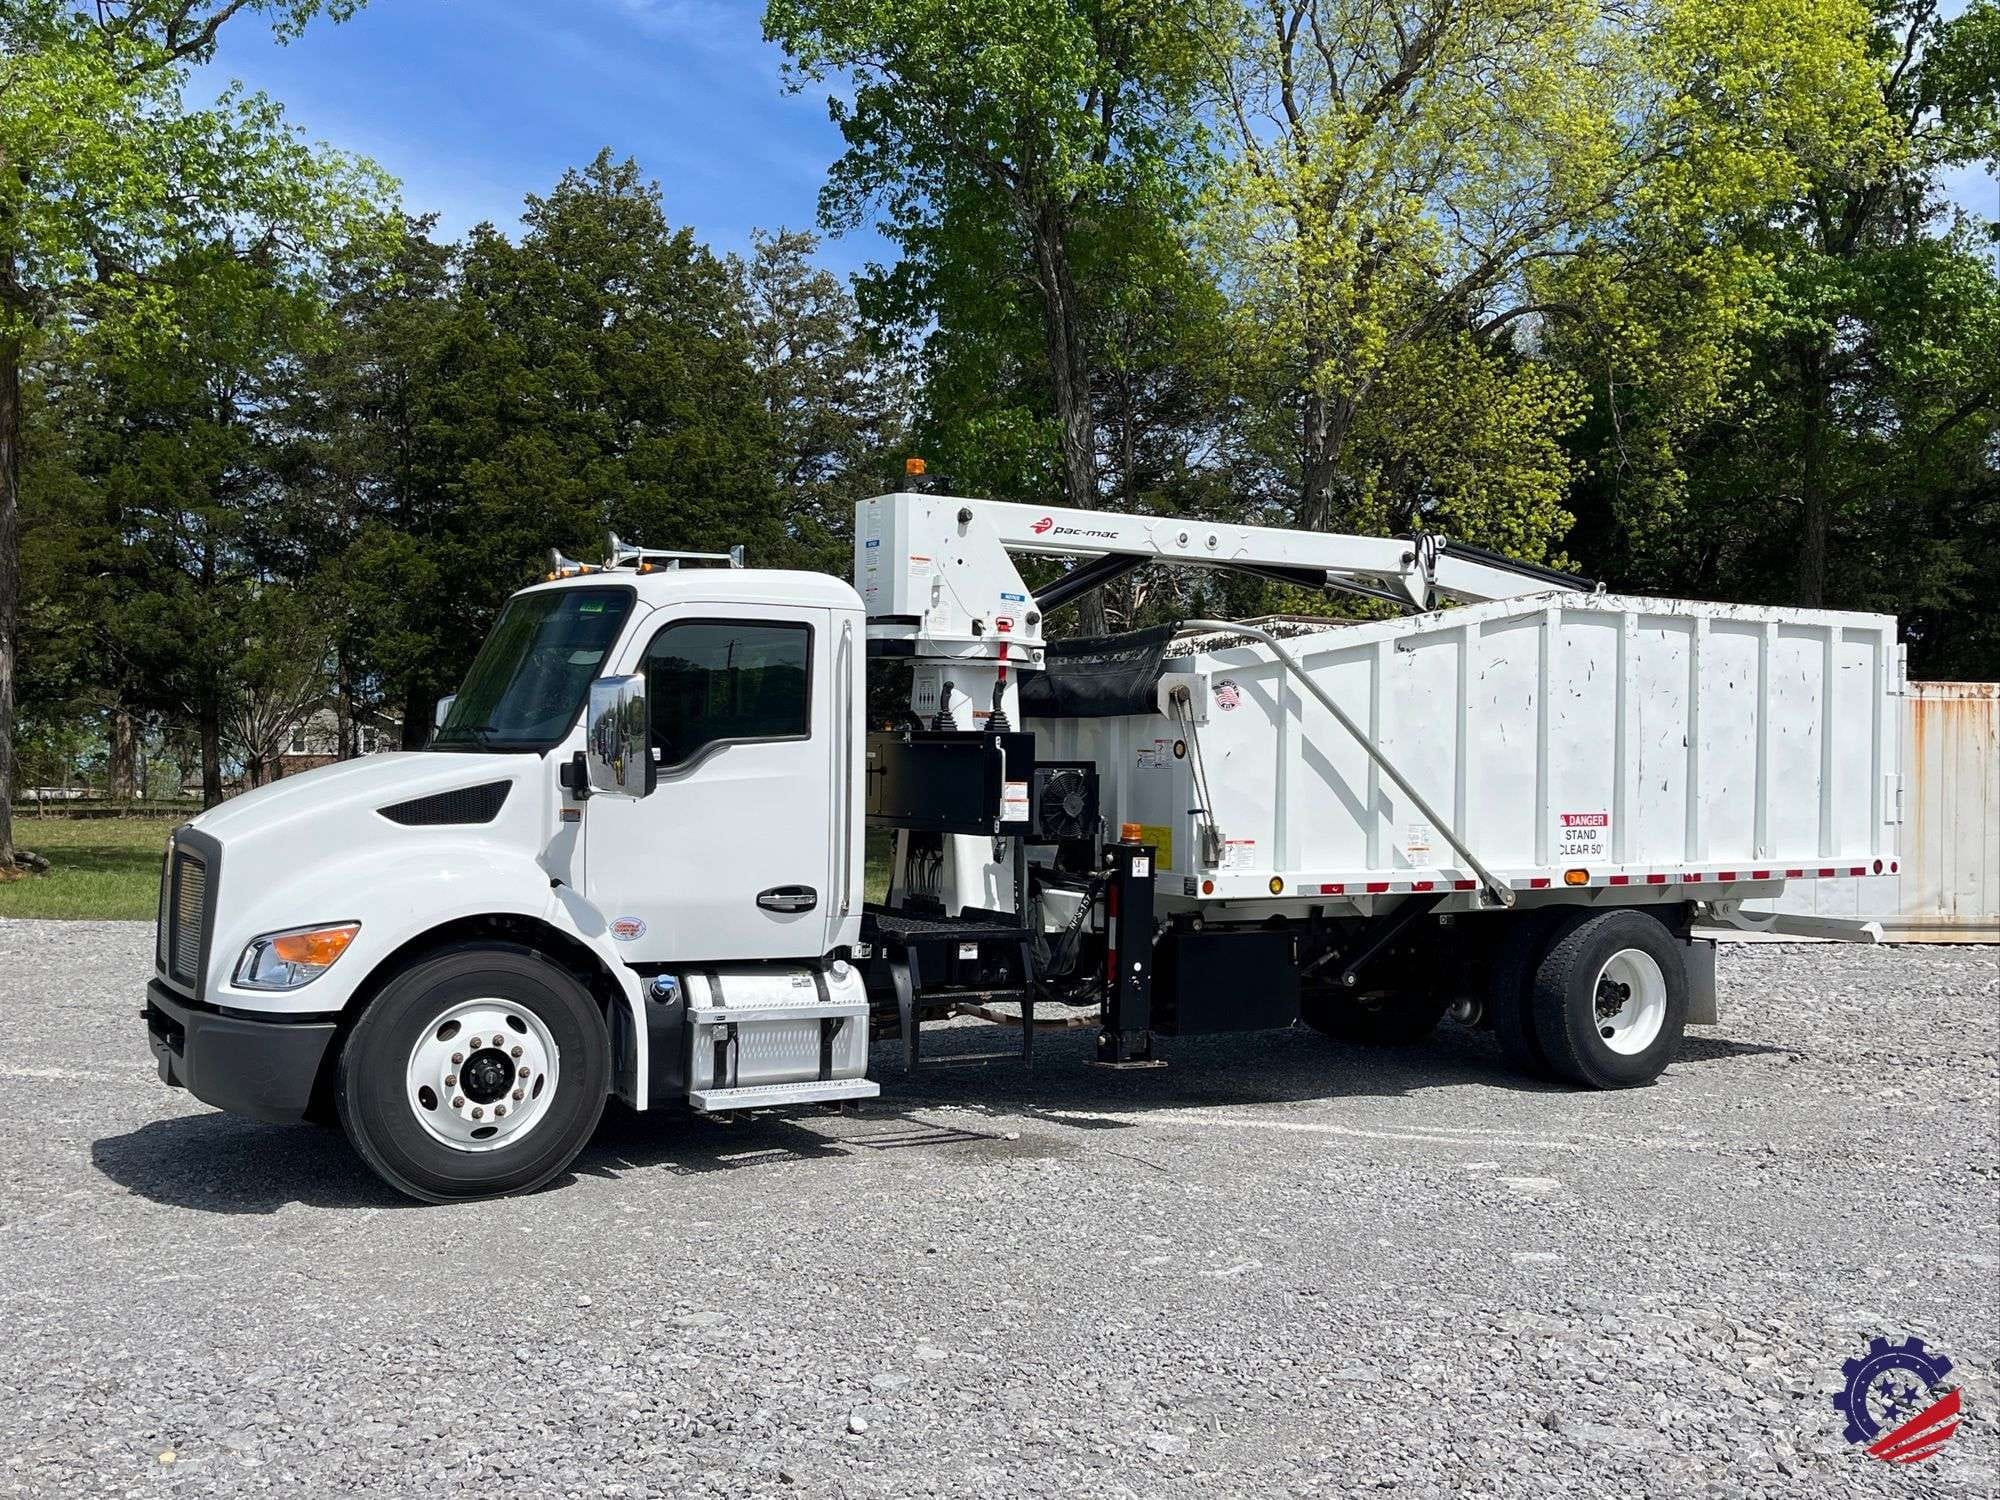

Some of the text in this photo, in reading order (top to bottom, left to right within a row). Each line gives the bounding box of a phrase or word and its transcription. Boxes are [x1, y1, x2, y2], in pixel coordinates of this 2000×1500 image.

[1053, 526, 1119, 539] pac-mac
[1568, 815, 1604, 826] DANGER
[1565, 829, 1597, 840] STAND
